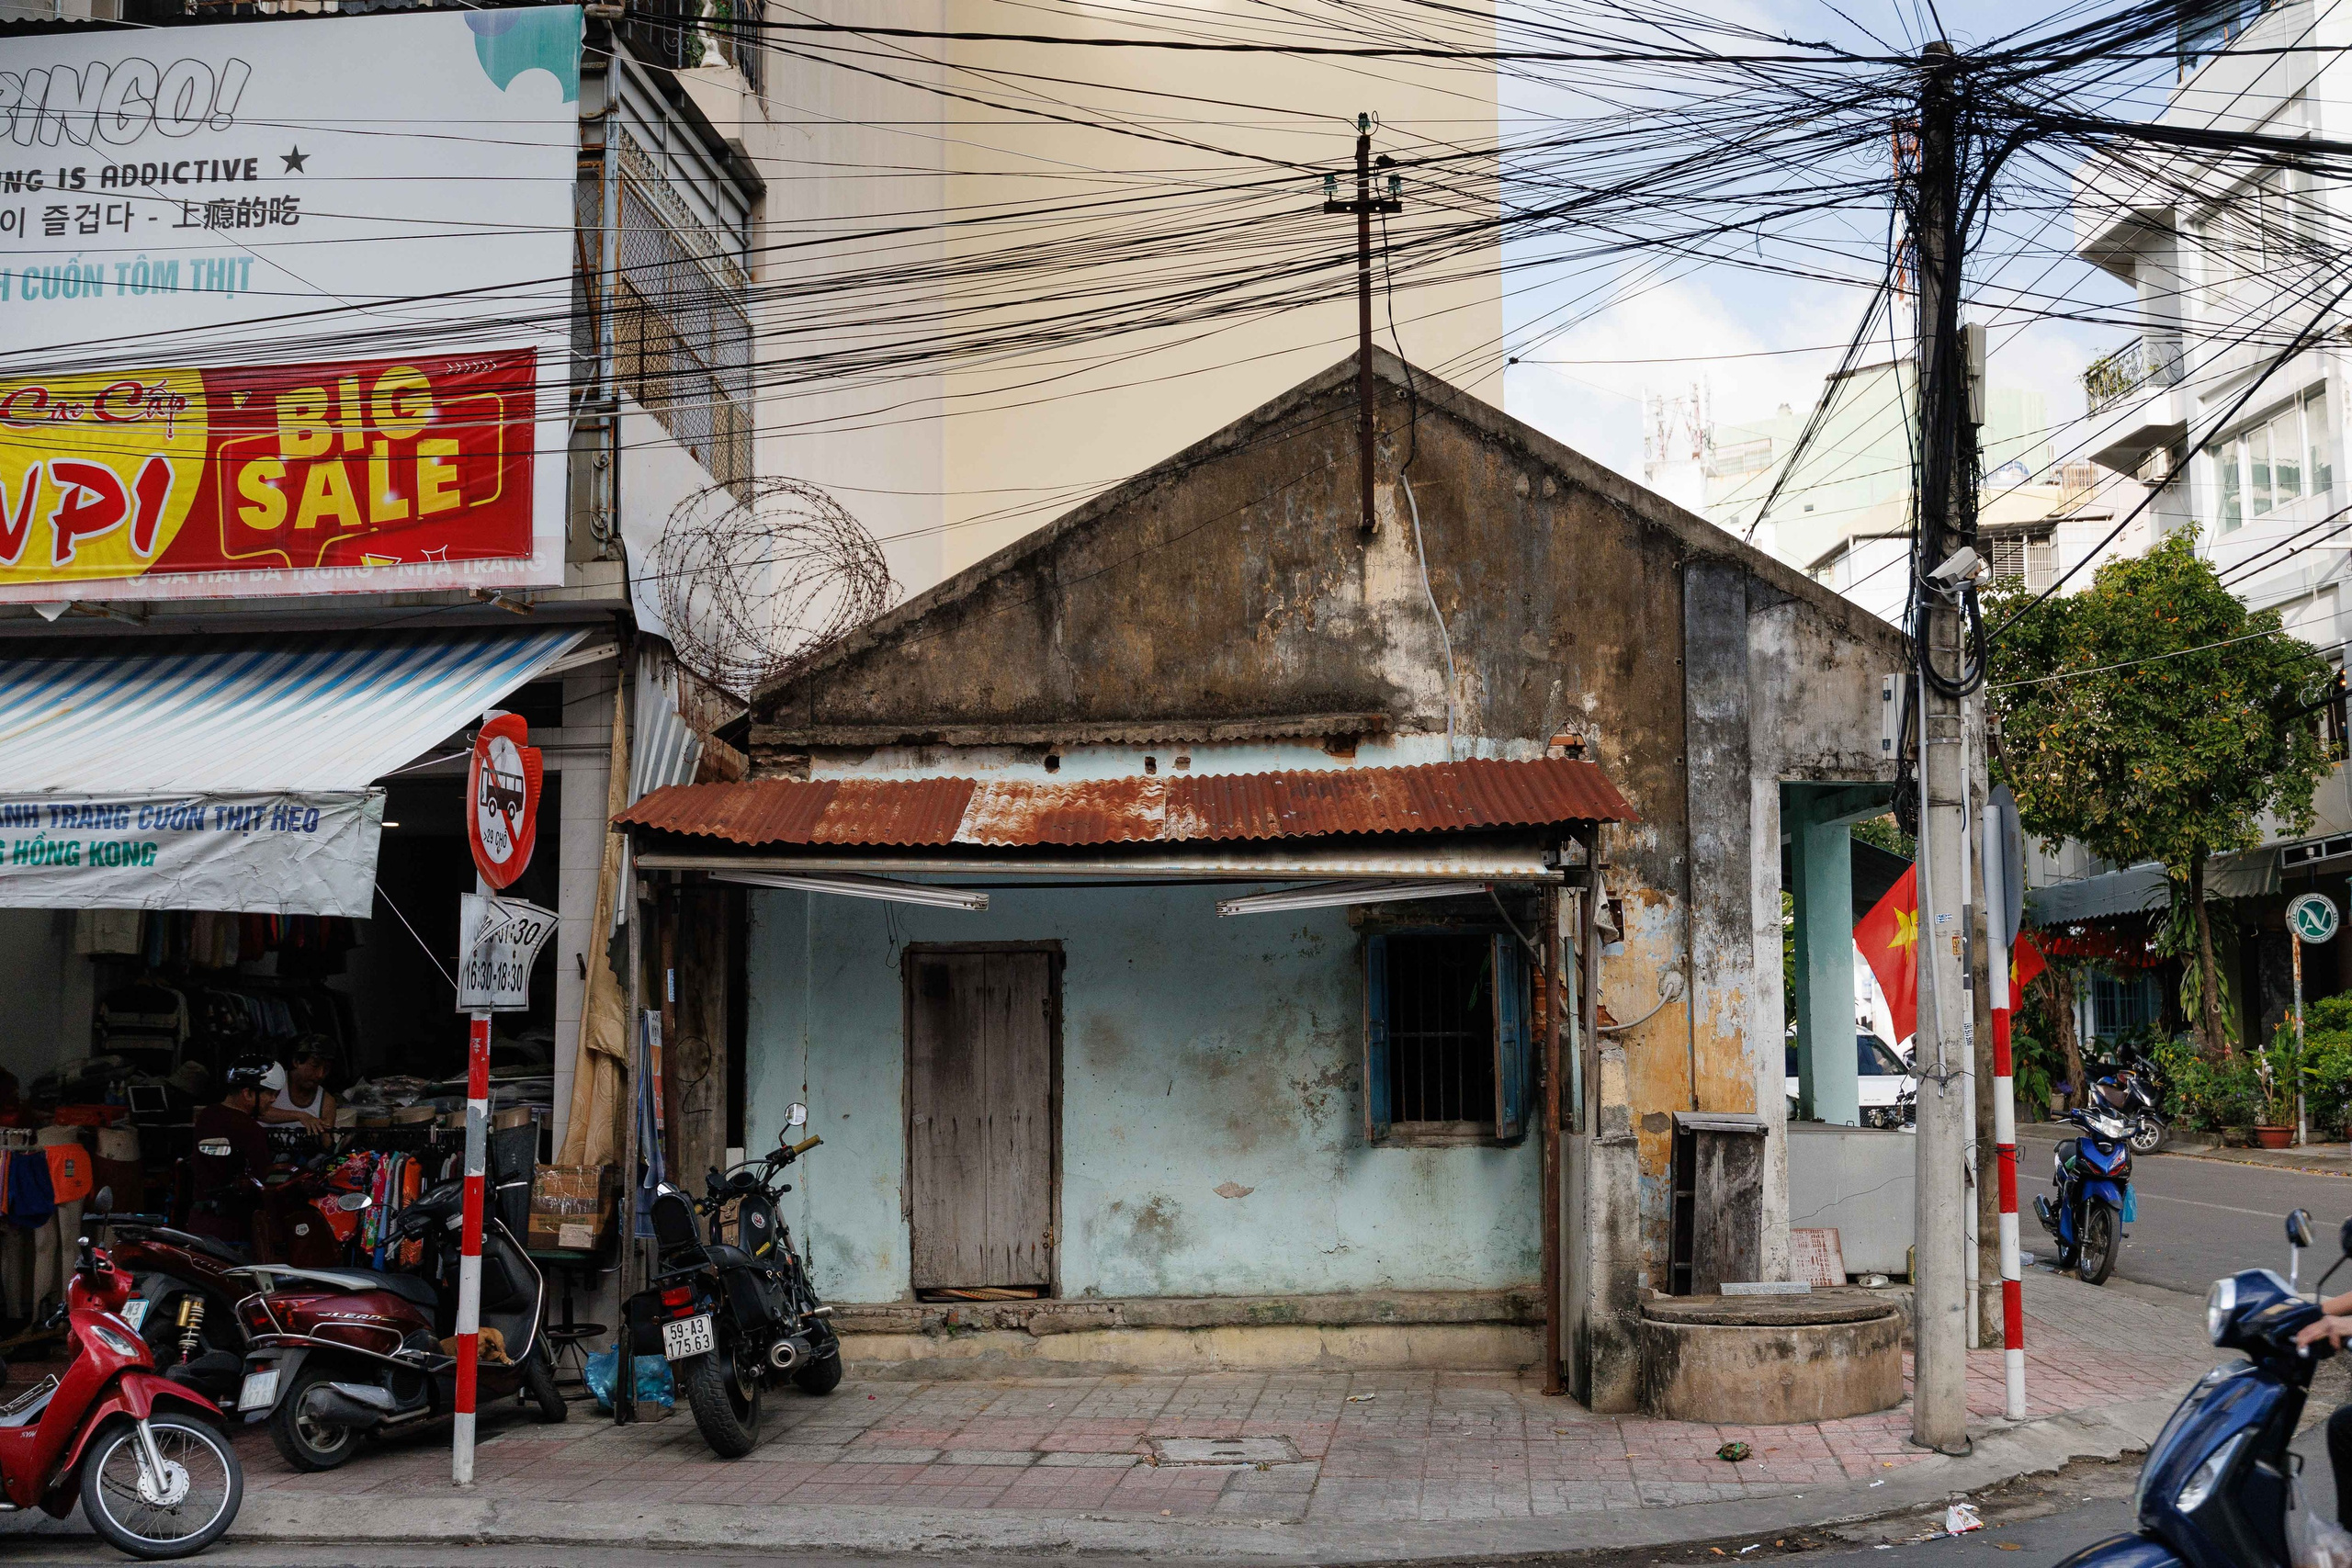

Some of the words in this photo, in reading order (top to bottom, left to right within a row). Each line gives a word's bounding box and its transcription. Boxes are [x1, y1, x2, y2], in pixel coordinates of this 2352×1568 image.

[0, 169, 44, 194] NG
[58, 167, 86, 190] IS
[101, 157, 258, 188] ADDICTIVE
[41, 201, 135, 237] 즐겁다
[173, 195, 300, 230] 上瘾的吃
[21, 252, 105, 300] CUỐN
[115, 254, 179, 297] TÔM
[189, 256, 254, 299] THỊT
[276, 367, 434, 461] BIG
[238, 438, 461, 531] SALE
[214, 805, 268, 837] THỊT
[13, 831, 81, 866] HỒNG
[89, 840, 158, 867] KONG
[466, 960, 523, 992] 16:30-18:30
[669, 1334, 710, 1357] 175.63
[670, 1319, 704, 1340] 59-A3
